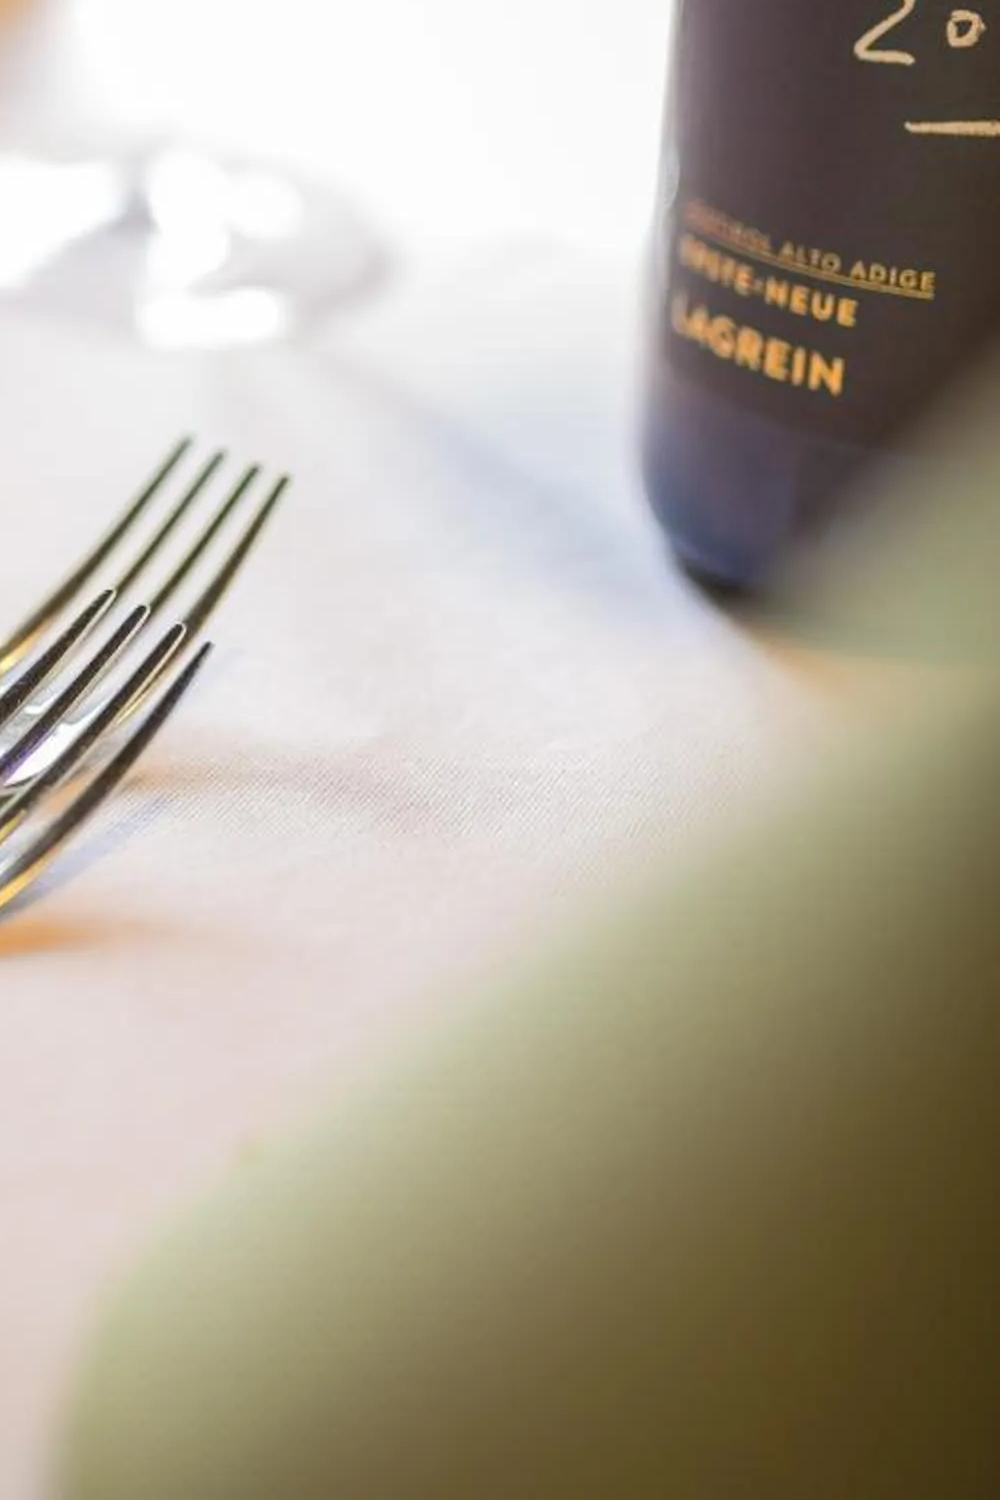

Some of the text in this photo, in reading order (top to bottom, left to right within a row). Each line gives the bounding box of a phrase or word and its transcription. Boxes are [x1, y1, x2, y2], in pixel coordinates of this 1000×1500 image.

[778, 241, 936, 293] ALTO ADIGE
[672, 288, 844, 396] LAGREIN
